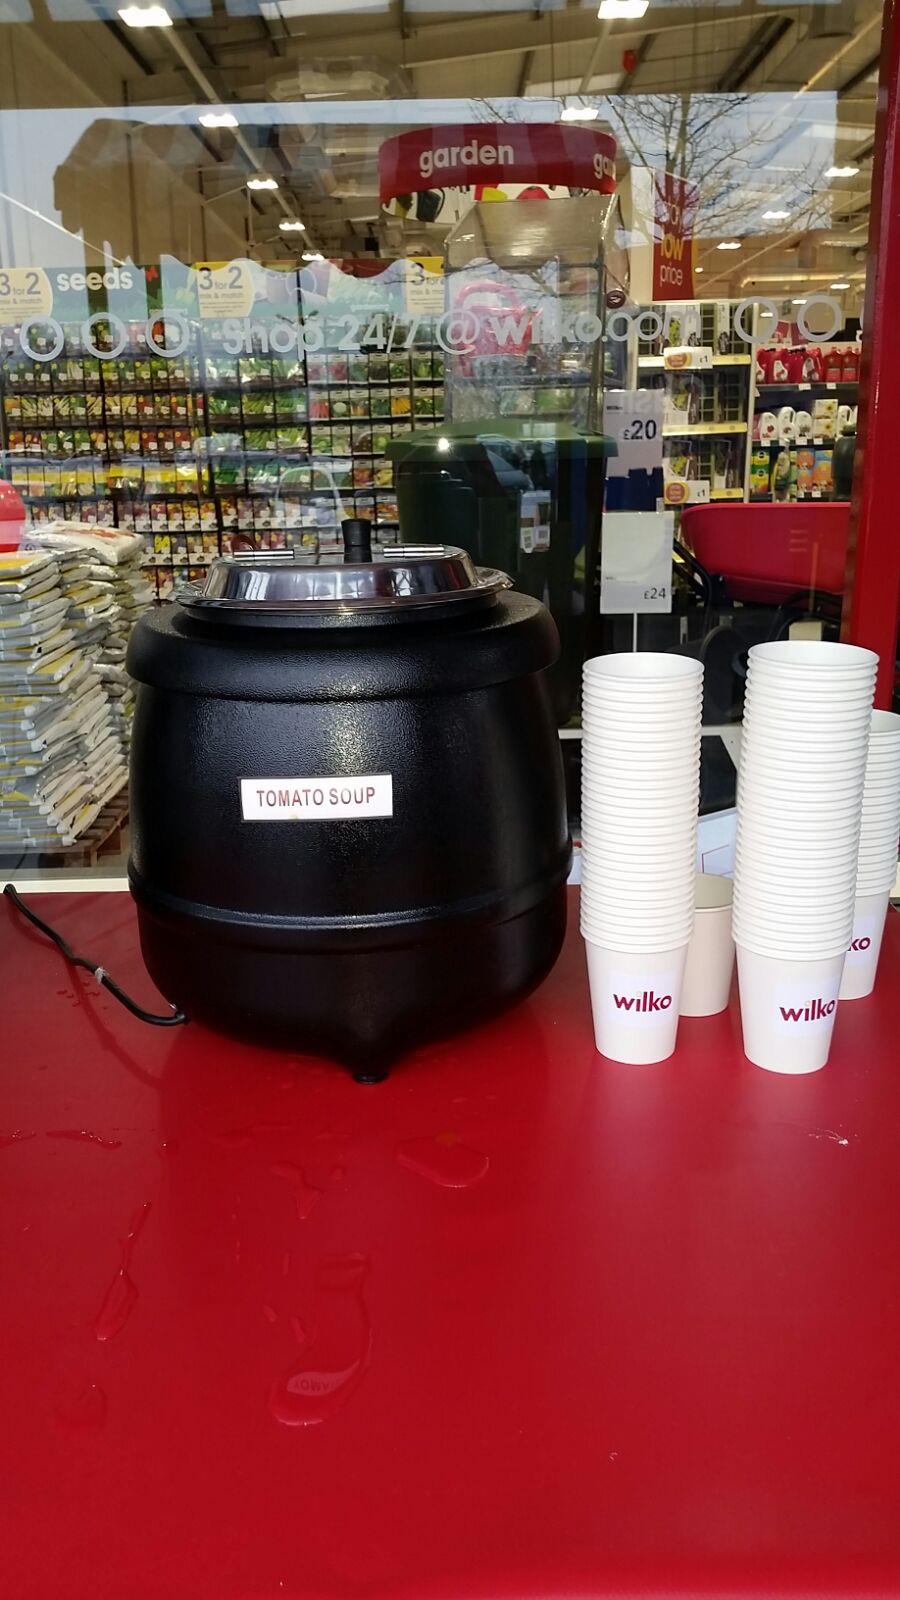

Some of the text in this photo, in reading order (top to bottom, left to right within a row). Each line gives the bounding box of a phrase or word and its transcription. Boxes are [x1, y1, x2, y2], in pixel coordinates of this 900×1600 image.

[419, 139, 514, 178] garden
[660, 233, 684, 261] low
[0, 272, 11, 296] 3
[25, 271, 42, 295] 2
[56, 270, 133, 291] seeds
[198, 266, 214, 290] 3
[228, 265, 243, 290] 2
[659, 262, 684, 288] price
[338, 312, 421, 354] 24/7
[435, 309, 481, 355] @
[488, 297, 702, 346] wilko.com
[623, 419, 657, 440] £20
[643, 587, 666, 600] £24
[256, 786, 376, 807] TOMATO SOUP
[613, 991, 672, 1012] wilko
[779, 998, 836, 1023] wilko
